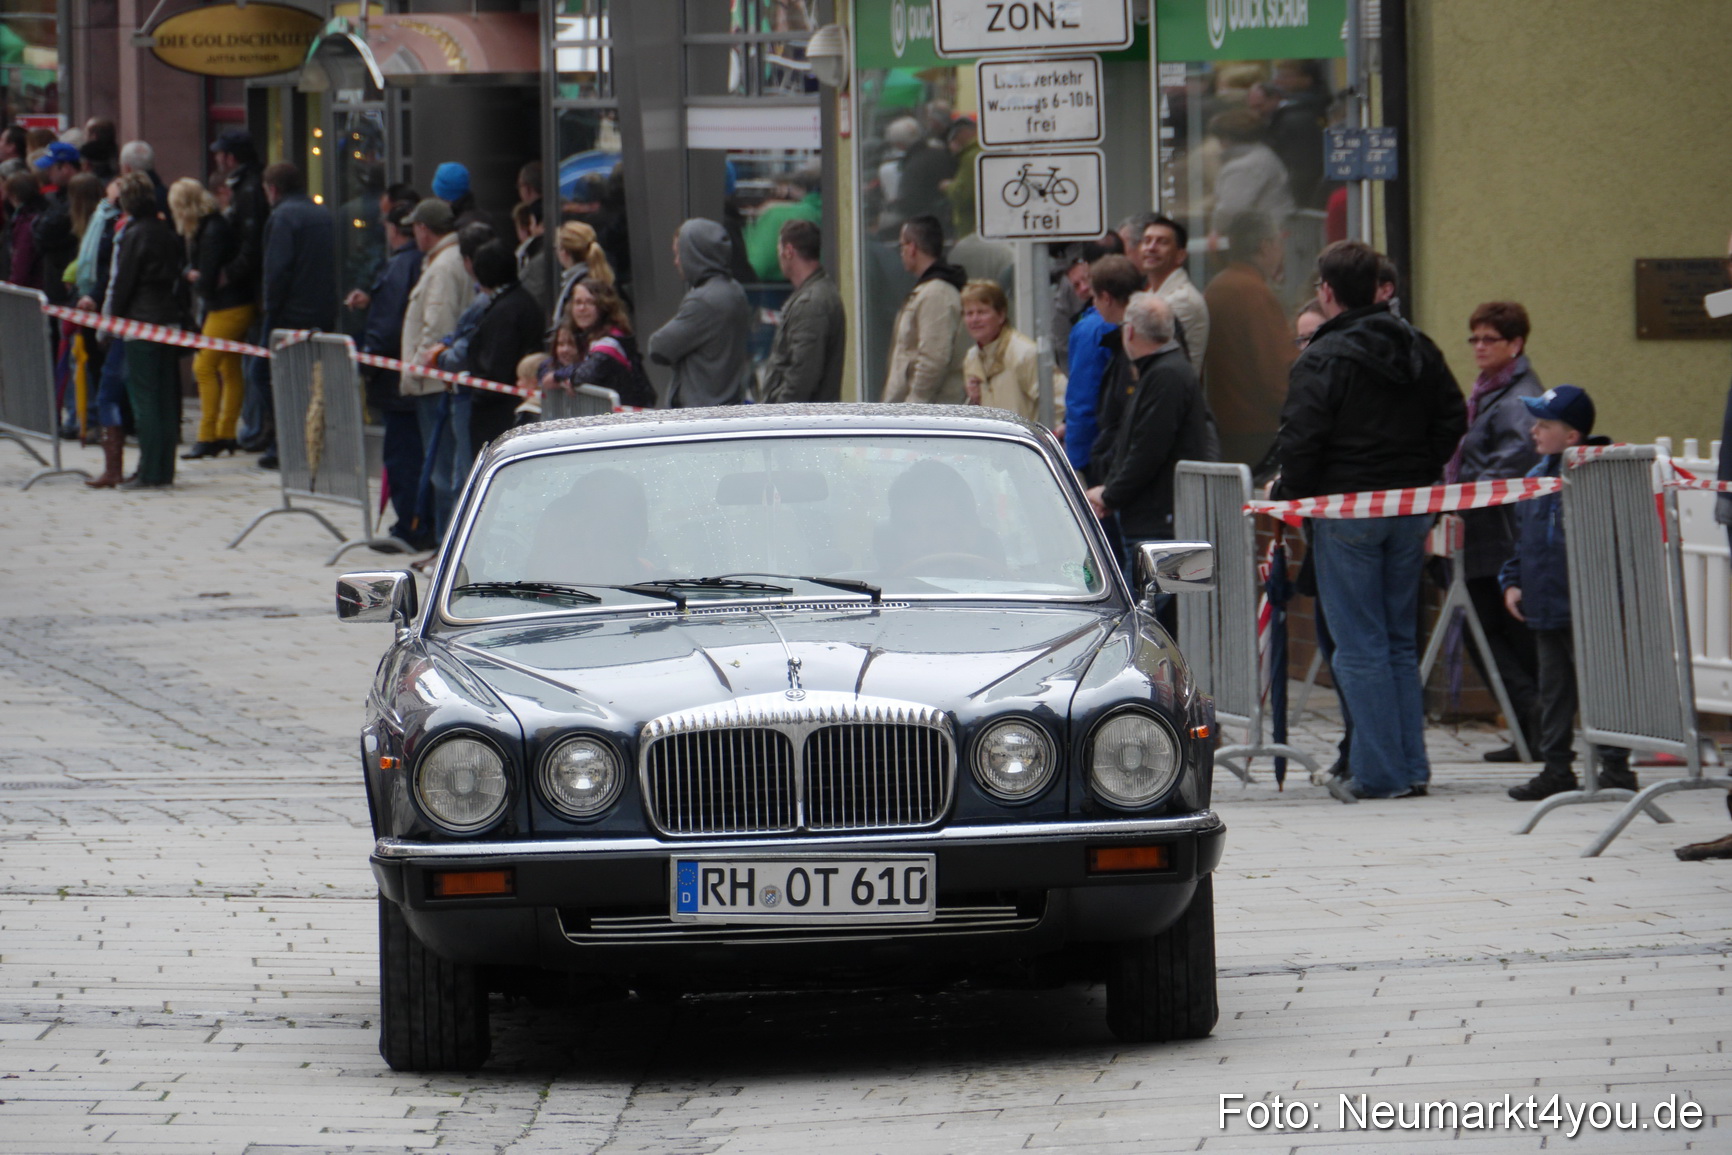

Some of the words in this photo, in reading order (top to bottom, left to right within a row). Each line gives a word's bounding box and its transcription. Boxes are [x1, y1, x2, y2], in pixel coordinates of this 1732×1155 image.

[159, 33, 188, 49] DIE
[1026, 116, 1056, 133] frei
[1022, 209, 1061, 230] frei
[702, 868, 756, 906] RH
[786, 867, 839, 907] OT
[851, 867, 927, 906] 610
[682, 893, 691, 904] D
